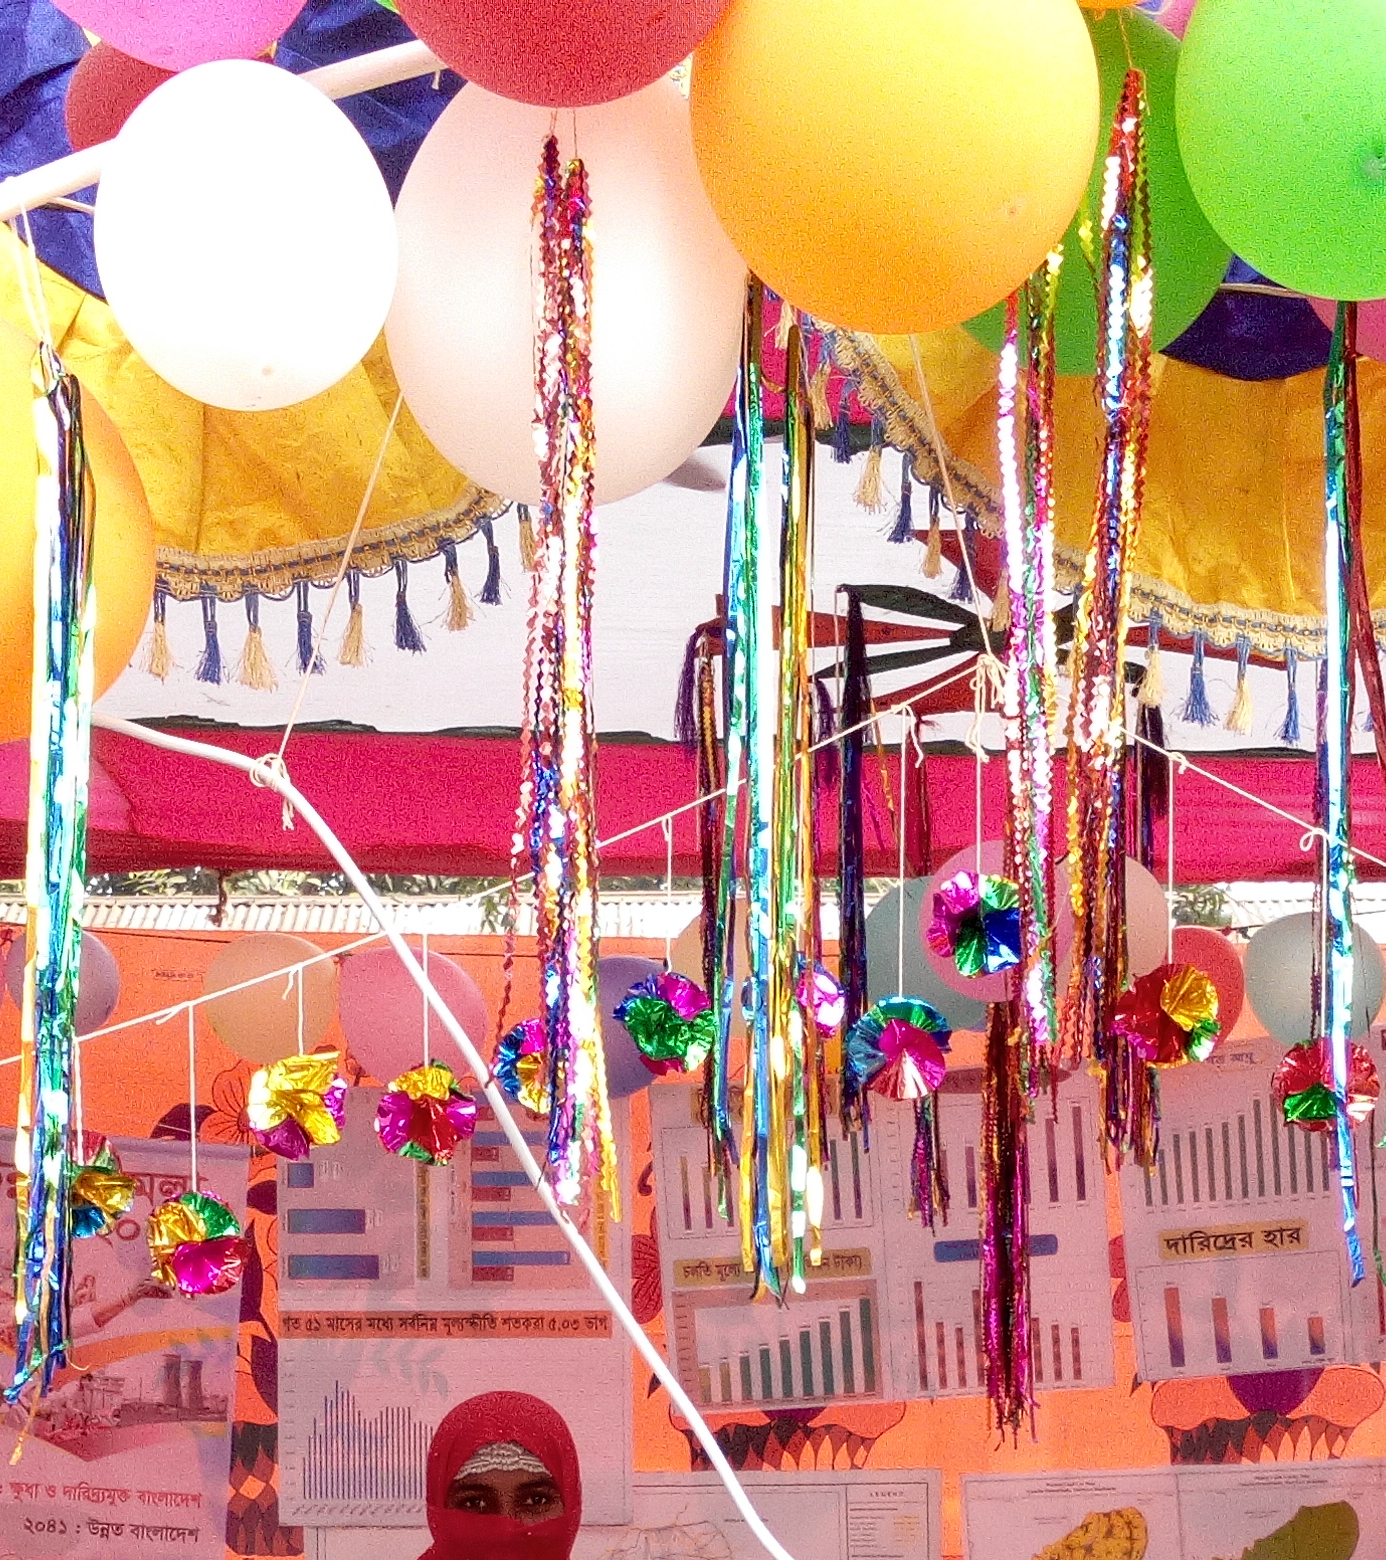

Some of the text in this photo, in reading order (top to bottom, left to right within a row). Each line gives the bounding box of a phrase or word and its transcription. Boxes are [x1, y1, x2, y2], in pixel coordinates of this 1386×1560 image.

[1262, 1224, 1302, 1250] হার
[326, 1317, 362, 1332] মাসের
[584, 1316, 609, 1331] ভাগ
[137, 1489, 202, 1510] বাংলাদেশ
[23, 1516, 199, 1544] ২০৪১ উন্নত বাংলাদেশ
